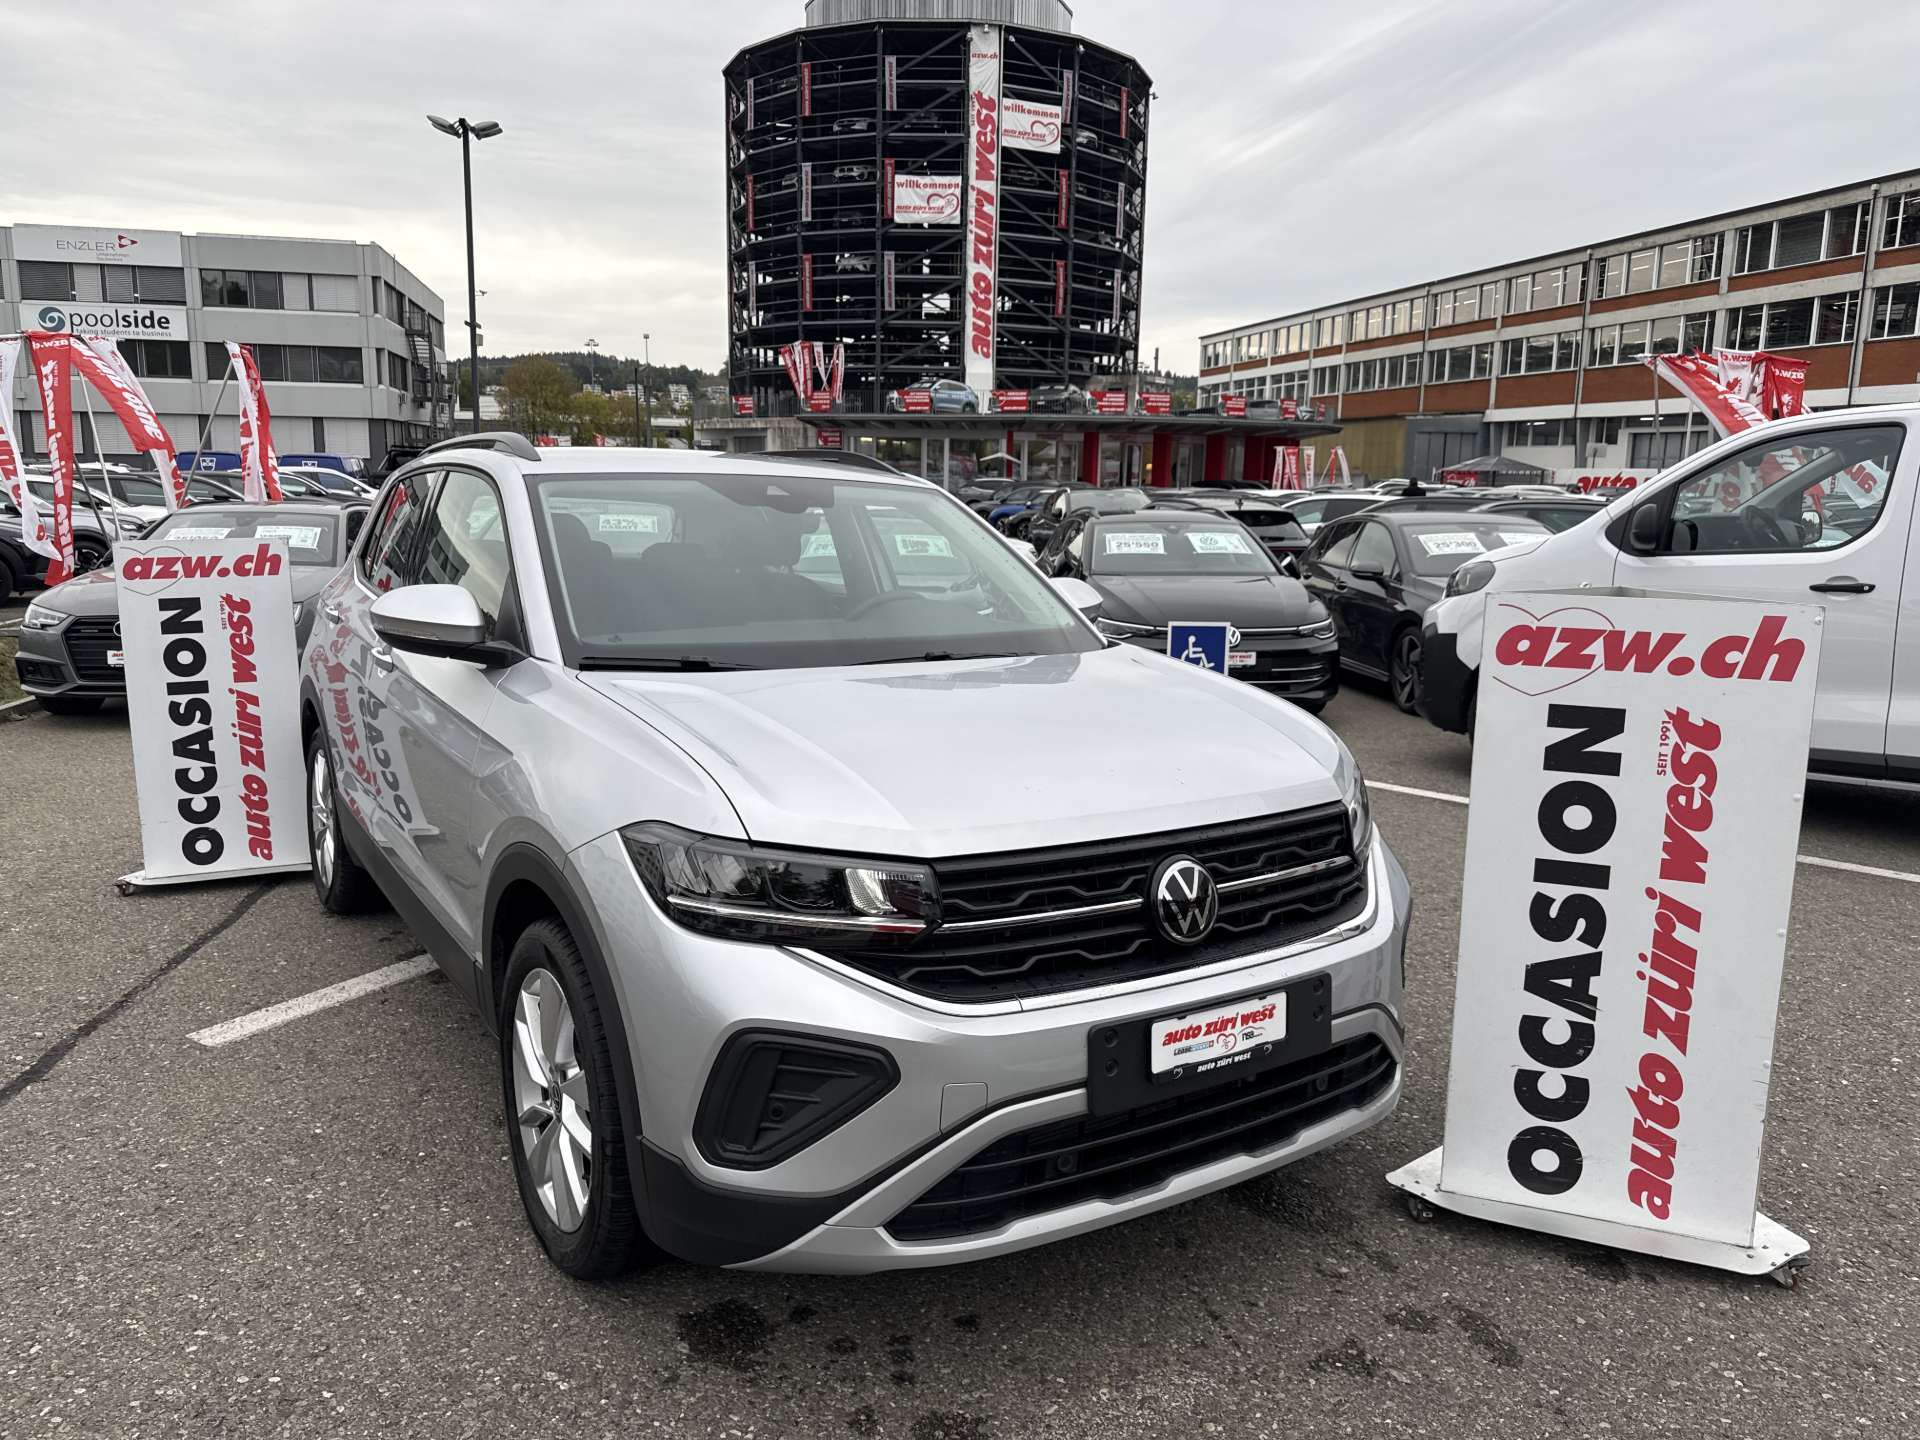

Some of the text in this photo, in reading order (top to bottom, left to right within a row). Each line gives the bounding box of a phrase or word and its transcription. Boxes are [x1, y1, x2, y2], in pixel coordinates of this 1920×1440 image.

[1003, 104, 1060, 118] willkommen
[896, 179, 960, 189] willkommen
[968, 90, 997, 359] auto züri west
[56, 239, 115, 251] ENZLER
[69, 308, 170, 334] poolside
[76, 328, 98, 336] taking
[101, 329, 131, 337] students
[142, 330, 171, 338] business
[1577, 471, 1637, 494] auto
[123, 544, 282, 580] azw.ch
[1495, 615, 1806, 682] azw.ch
[158, 597, 224, 865] OCCASION
[220, 593, 273, 860] auto züri west
[1656, 720, 1672, 777] SEIT 1991
[1507, 703, 1627, 1195] OCCASION
[1625, 706, 1722, 1220] auto züri west
[1161, 1023, 1202, 1047] auto
[1203, 1011, 1240, 1036] züri
[1240, 1003, 1277, 1027] west
[1196, 1052, 1252, 1073] auto züri west
